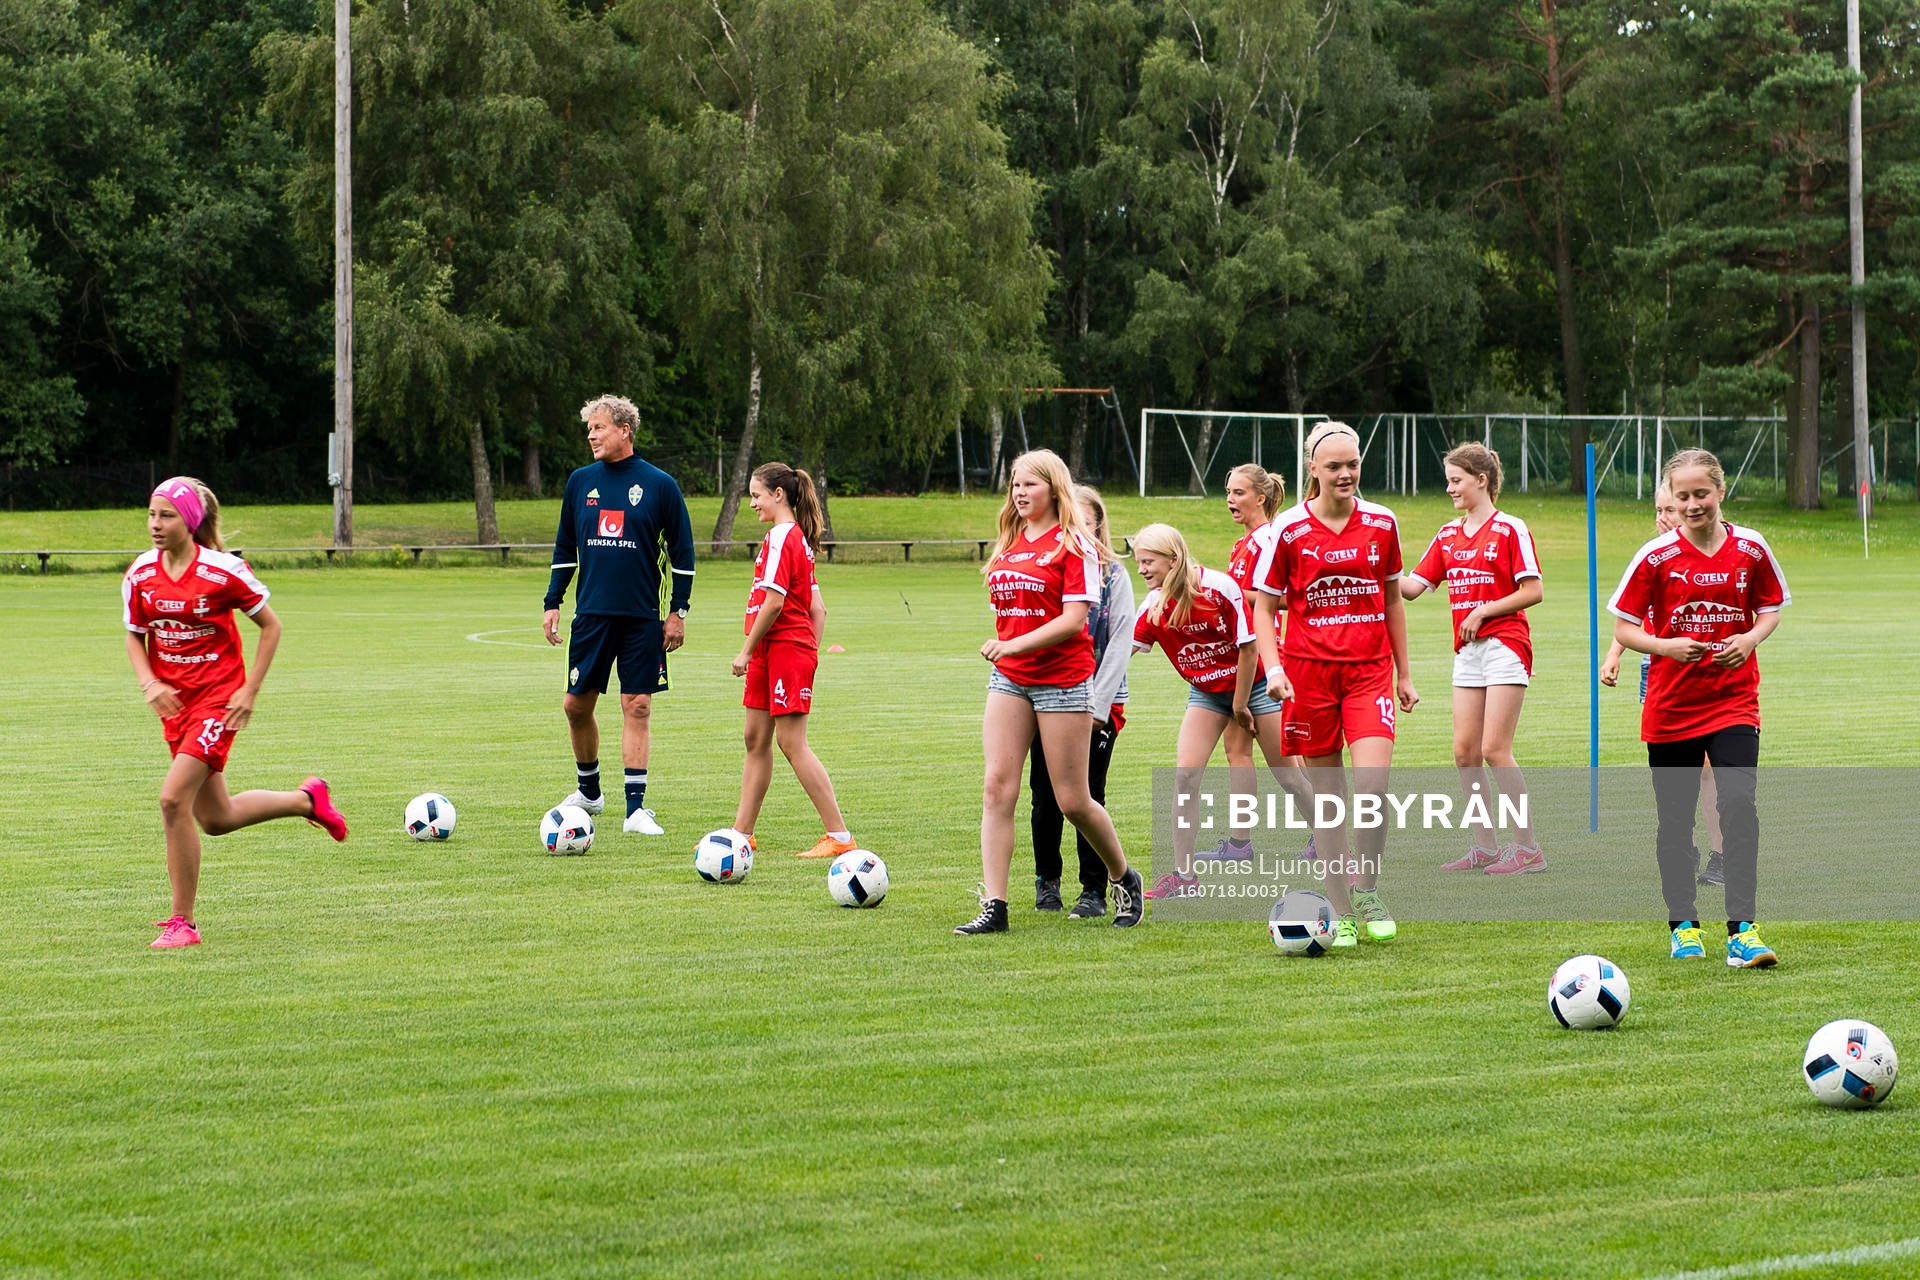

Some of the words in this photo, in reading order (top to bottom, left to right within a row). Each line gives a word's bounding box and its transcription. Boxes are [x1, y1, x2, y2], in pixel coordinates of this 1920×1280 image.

[587, 539, 617, 547] SVENSKA
[618, 540, 637, 549] SPEL
[1308, 599, 1328, 609] VVS
[1338, 597, 1350, 605] EL
[1671, 624, 1692, 632] VVS
[1694, 624, 1700, 632] &
[1702, 624, 1714, 632] EL
[774, 678, 785, 696] 4
[1376, 696, 1394, 720] 12
[202, 718, 224, 742] 13
